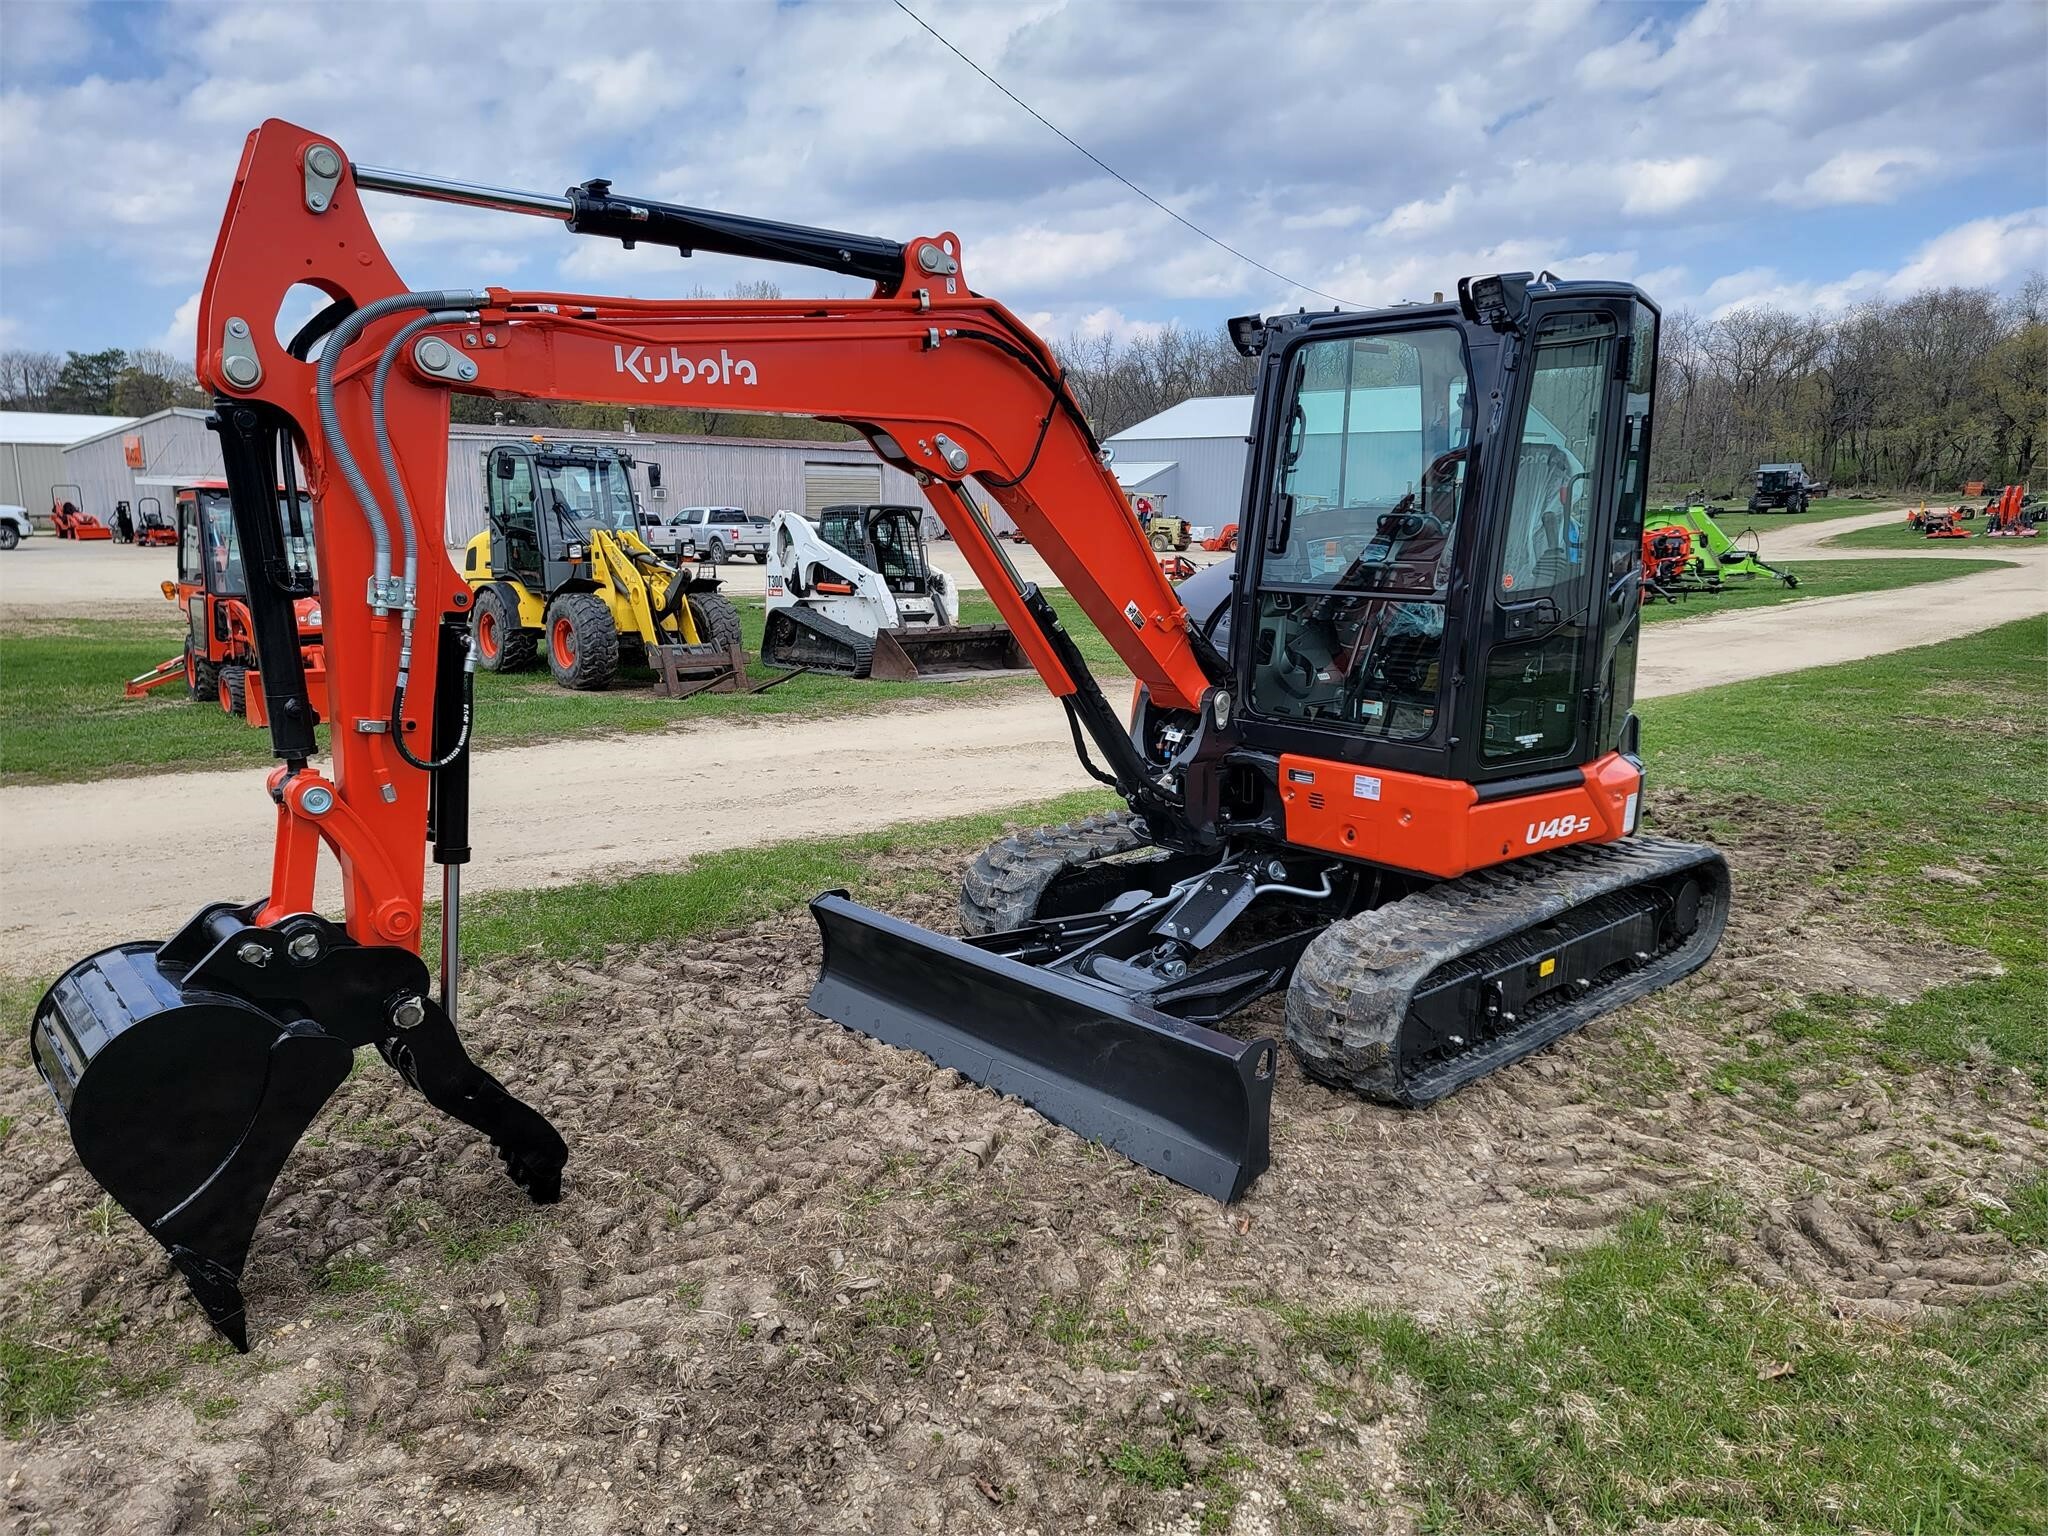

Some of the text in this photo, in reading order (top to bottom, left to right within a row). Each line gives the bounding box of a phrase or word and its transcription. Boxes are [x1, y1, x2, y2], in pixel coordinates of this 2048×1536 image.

[614, 345, 757, 385] Kubota
[768, 575, 783, 588] T300
[1526, 815, 1591, 844] U48-5
